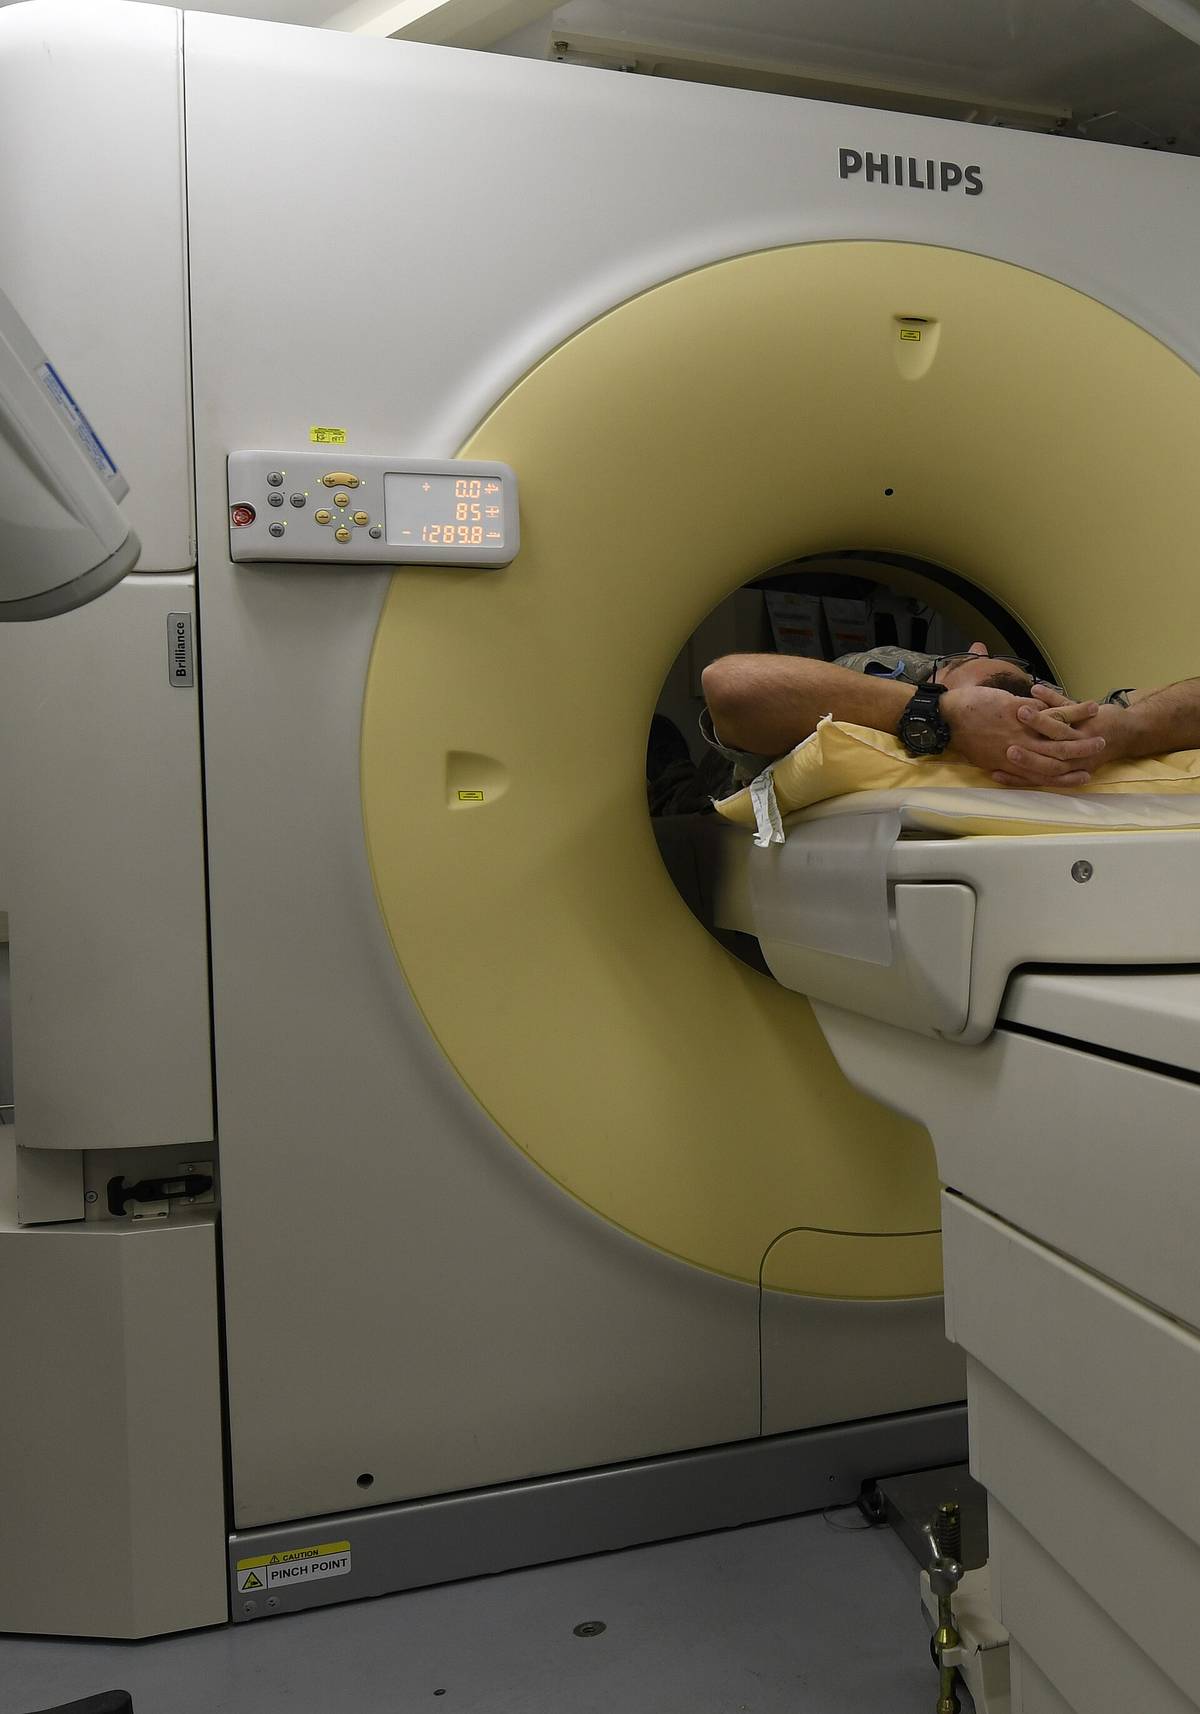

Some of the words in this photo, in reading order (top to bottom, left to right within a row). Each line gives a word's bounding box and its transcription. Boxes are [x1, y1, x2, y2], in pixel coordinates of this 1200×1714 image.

[838, 148, 984, 196] PHILIPS
[456, 479, 481, 498] 0.0
[456, 502, 481, 521] 85
[422, 524, 483, 544] 1289.8
[174, 622, 187, 677] Brilliance
[282, 1549, 319, 1561] CAUTION
[271, 1565, 308, 1580] PINCH
[312, 1558, 348, 1573] POINT
